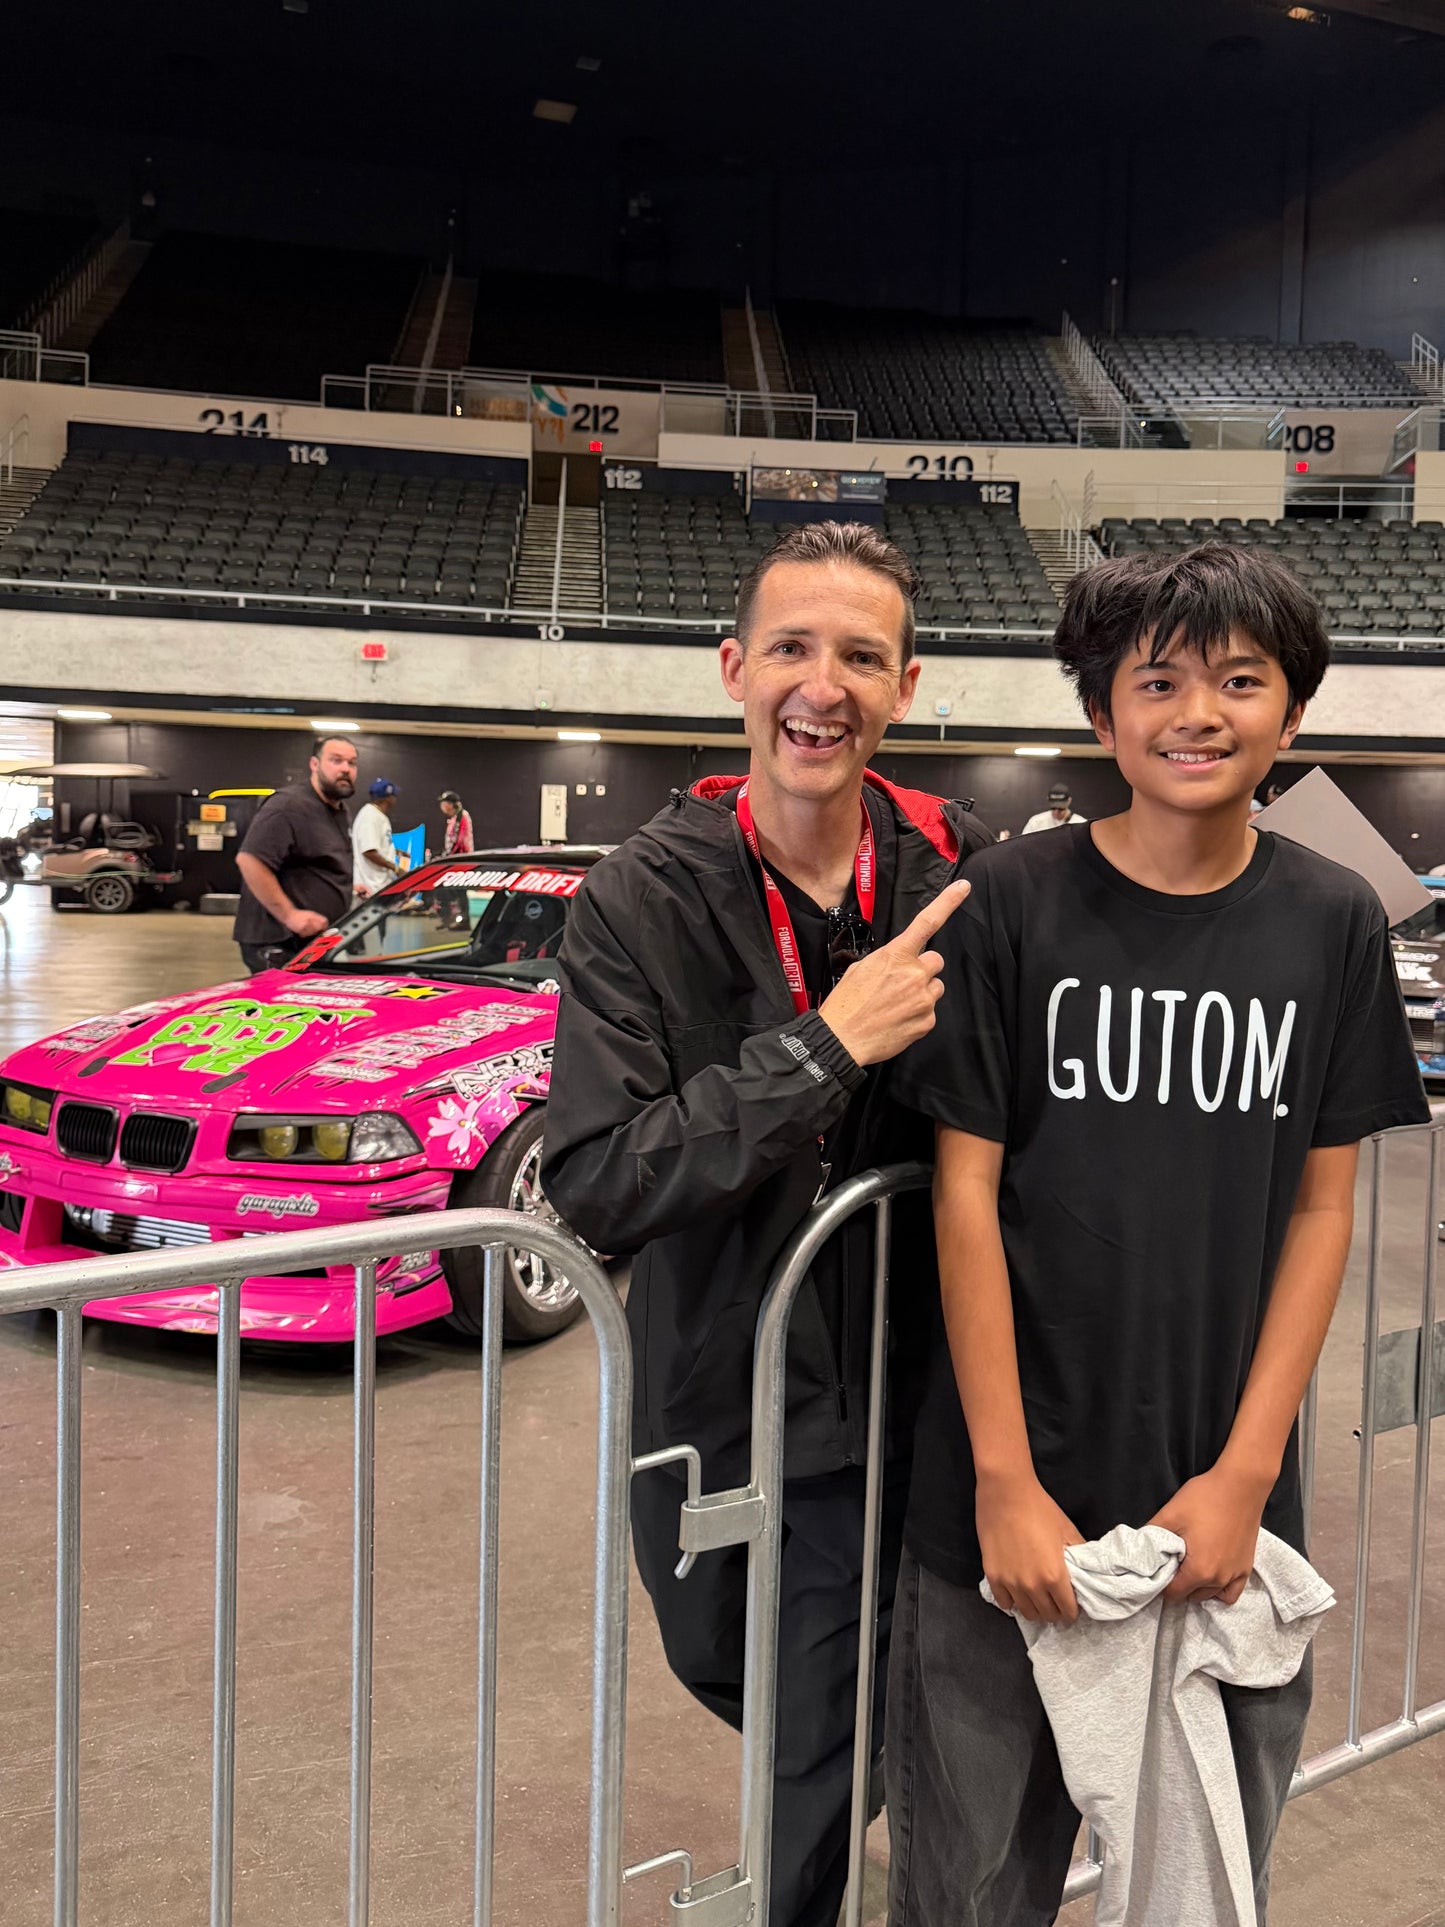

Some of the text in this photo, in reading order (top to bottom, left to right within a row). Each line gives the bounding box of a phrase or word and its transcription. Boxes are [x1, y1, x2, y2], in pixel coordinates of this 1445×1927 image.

[199, 409, 271, 438] 214
[572, 403, 619, 434] 212
[288, 444, 329, 465] 114
[605, 468, 643, 490] 112
[979, 484, 1013, 504] 112
[537, 624, 565, 641] 10
[433, 871, 585, 895] FORMULA DRIFT
[859, 856, 871, 892] FORMULA
[777, 926, 802, 993] FORMULA DRIFT
[151, 1014, 308, 1052] COCO
[1047, 977, 1298, 1120] GUTOM.
